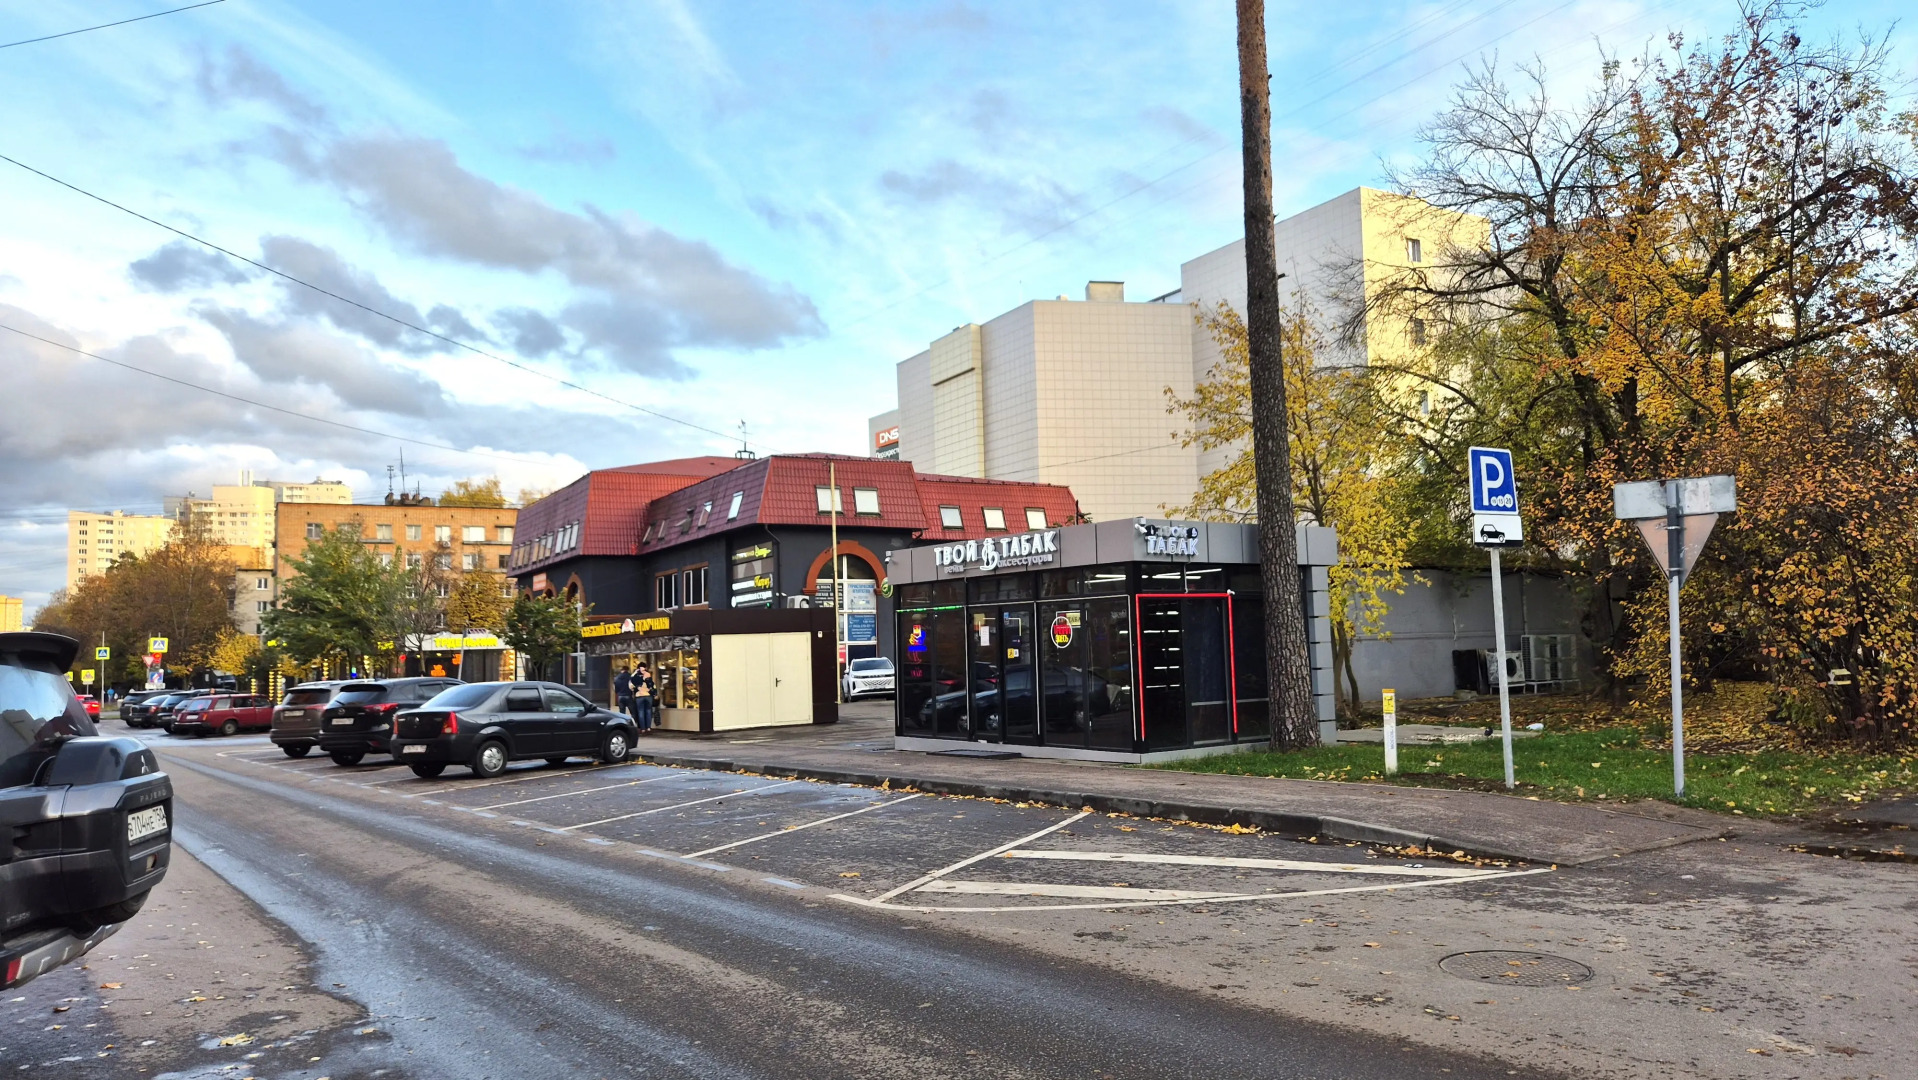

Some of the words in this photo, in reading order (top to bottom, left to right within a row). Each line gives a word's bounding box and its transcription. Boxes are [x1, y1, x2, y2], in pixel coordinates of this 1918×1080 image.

[879, 429, 899, 443] DNS
[1480, 456, 1504, 506] P
[934, 540, 978, 566] ТВОЙ
[1000, 531, 1057, 558] ТАБАК
[1146, 536, 1199, 555] ТАБАК
